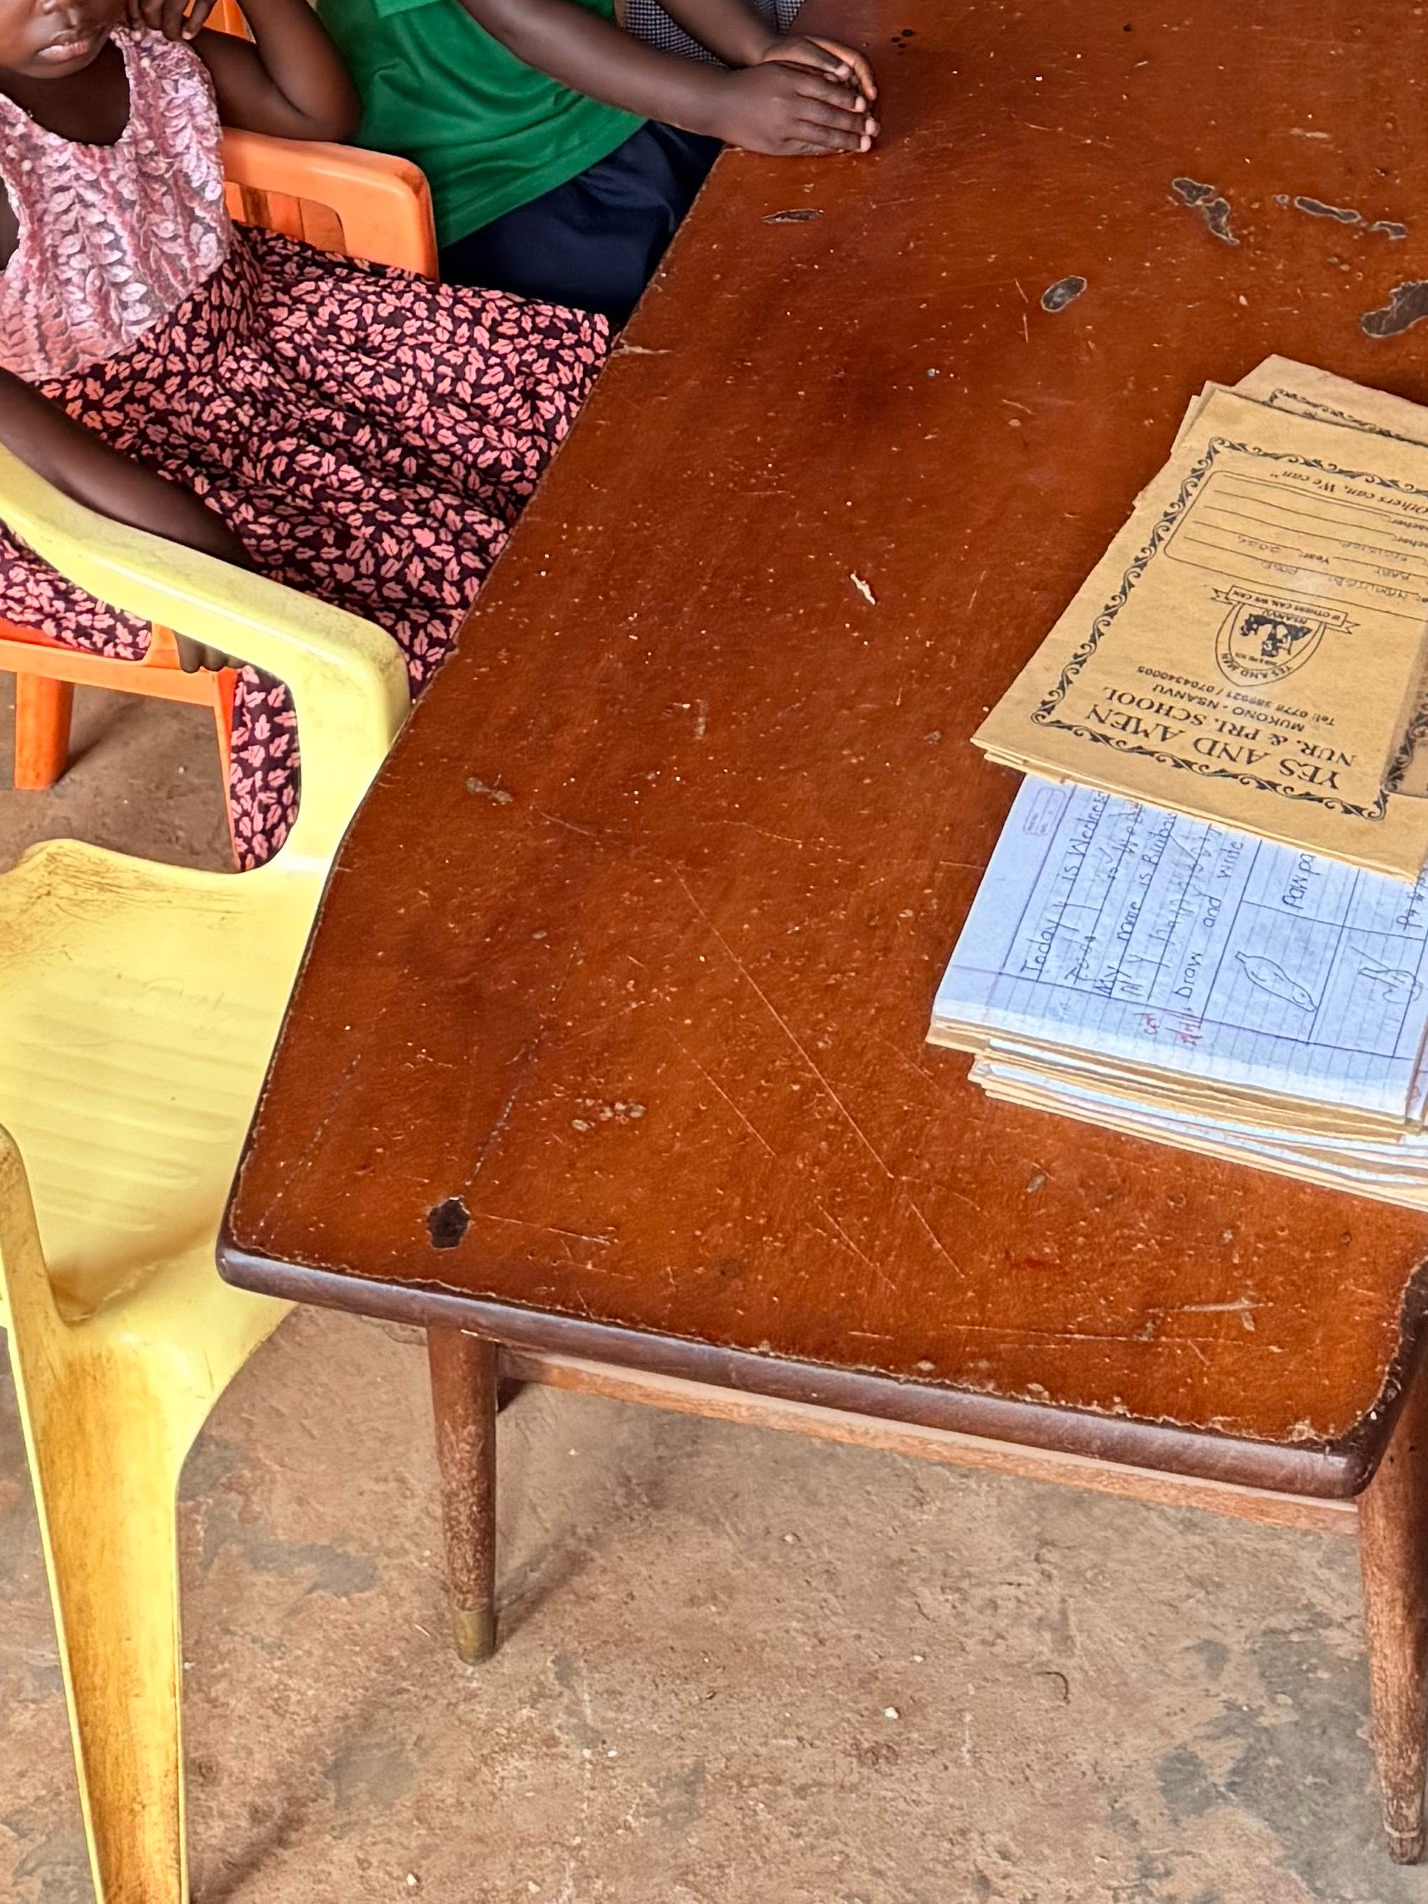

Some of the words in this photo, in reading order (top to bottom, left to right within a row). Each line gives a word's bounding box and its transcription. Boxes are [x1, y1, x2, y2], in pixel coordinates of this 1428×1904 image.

[1313, 478, 1336, 493] We
[1102, 686, 1208, 727] SCHOOL
[1152, 683, 1220, 710] NSANVU
[1085, 704, 1186, 743] AMEN
[1213, 718, 1265, 743] PRI.
[1232, 705, 1305, 733] MUKONO
[1193, 736, 1271, 767] AND
[1270, 733, 1289, 748] &
[1293, 739, 1357, 767] NUR.
[1280, 757, 1341, 790] YES
